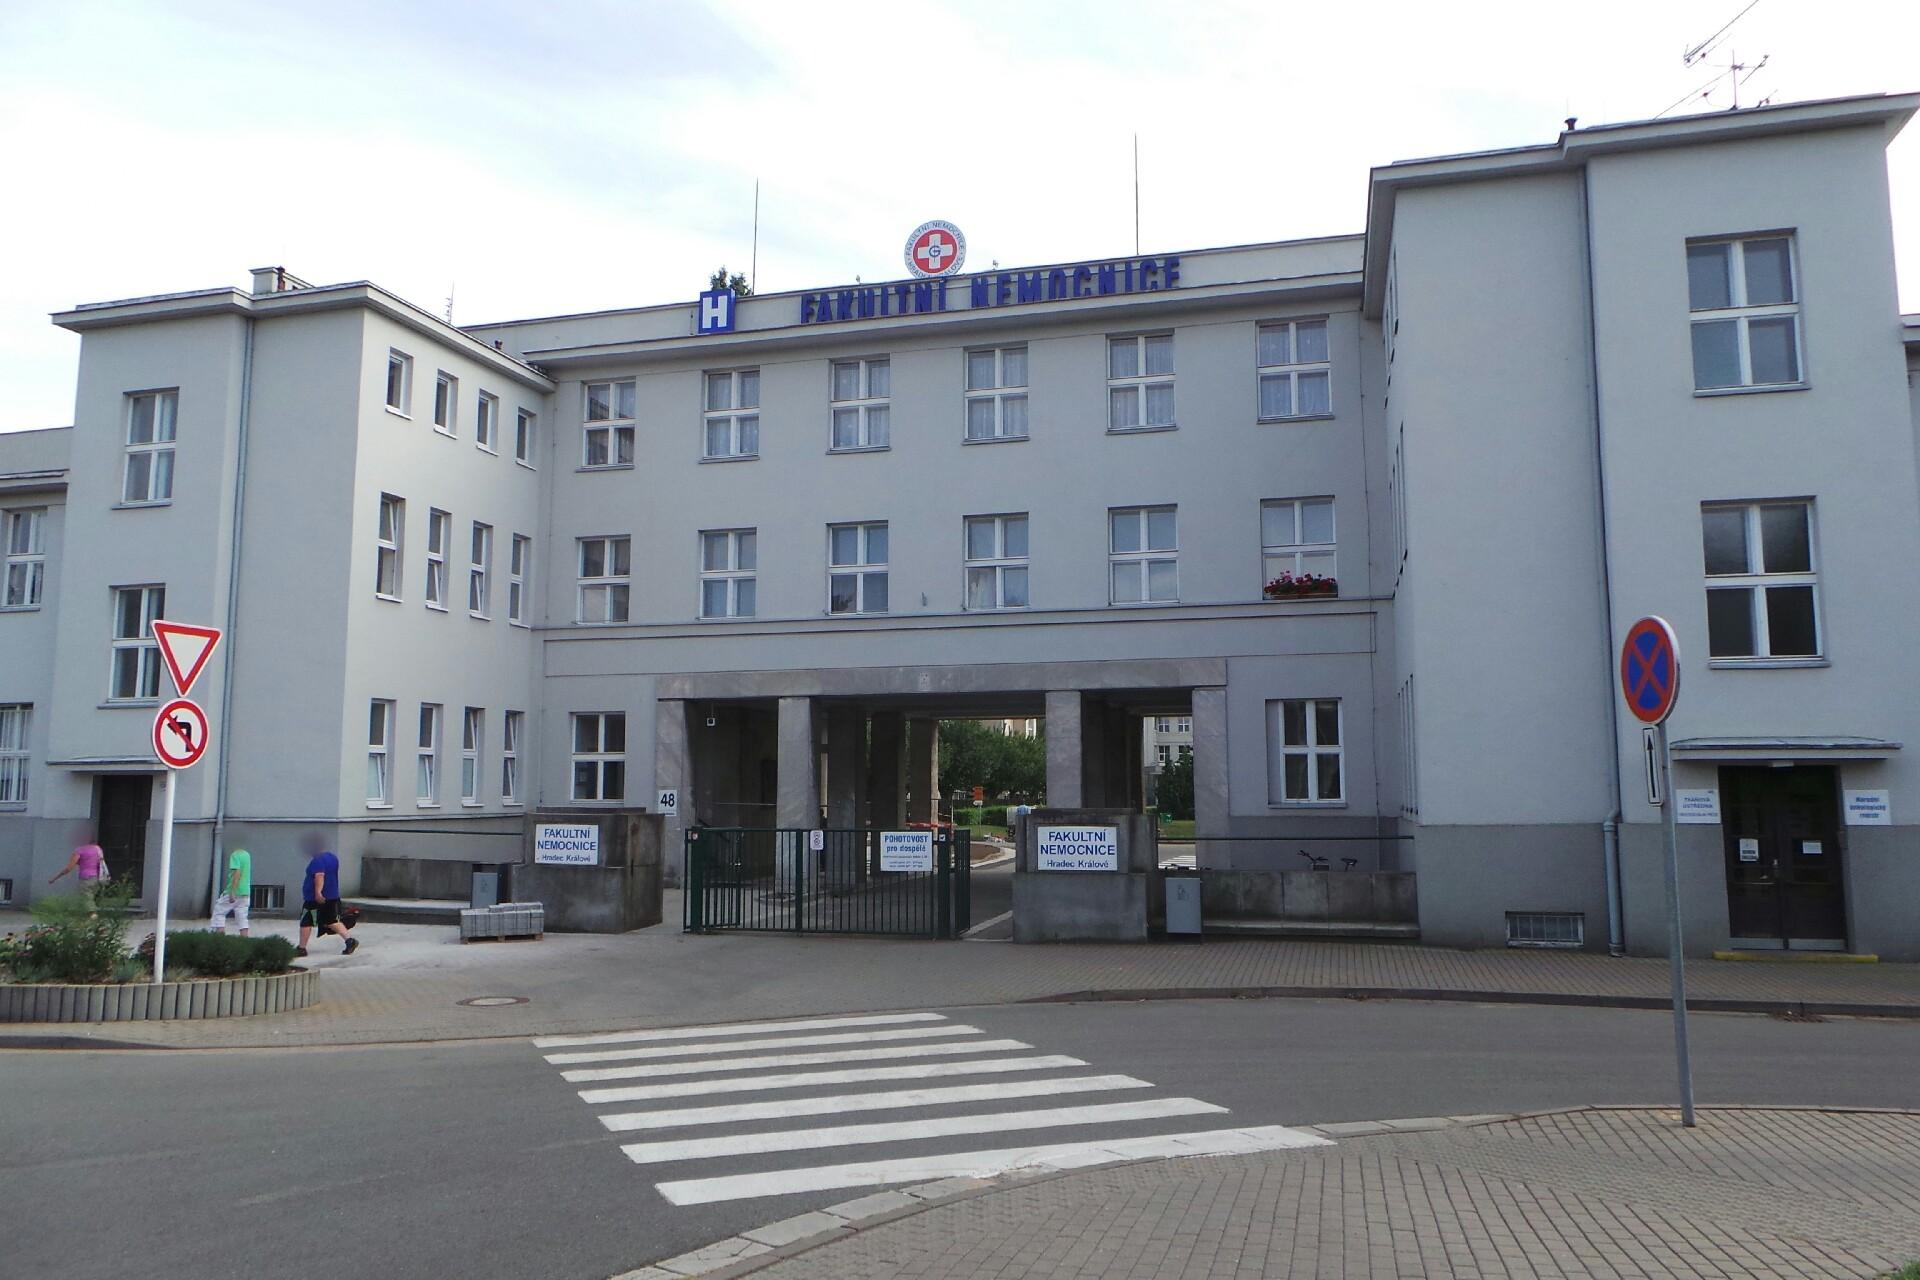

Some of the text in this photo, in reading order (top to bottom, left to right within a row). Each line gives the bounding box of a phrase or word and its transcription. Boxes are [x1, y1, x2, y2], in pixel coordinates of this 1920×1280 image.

[800, 256, 1180, 324] FAKULTNÍ NEMOCNICE
[702, 295, 728, 329] H
[660, 793, 675, 807] 48
[544, 826, 590, 838] FAKULTNÍ
[1048, 829, 1106, 842] FAKULTNÍ
[884, 835, 929, 843] POHOTOVOST
[537, 841, 597, 851] NEMOCNICE
[1040, 844, 1116, 856] NEMOCNICE
[542, 854, 591, 863] Hradec Králové
[1046, 859, 1109, 868] Hradec Králové
